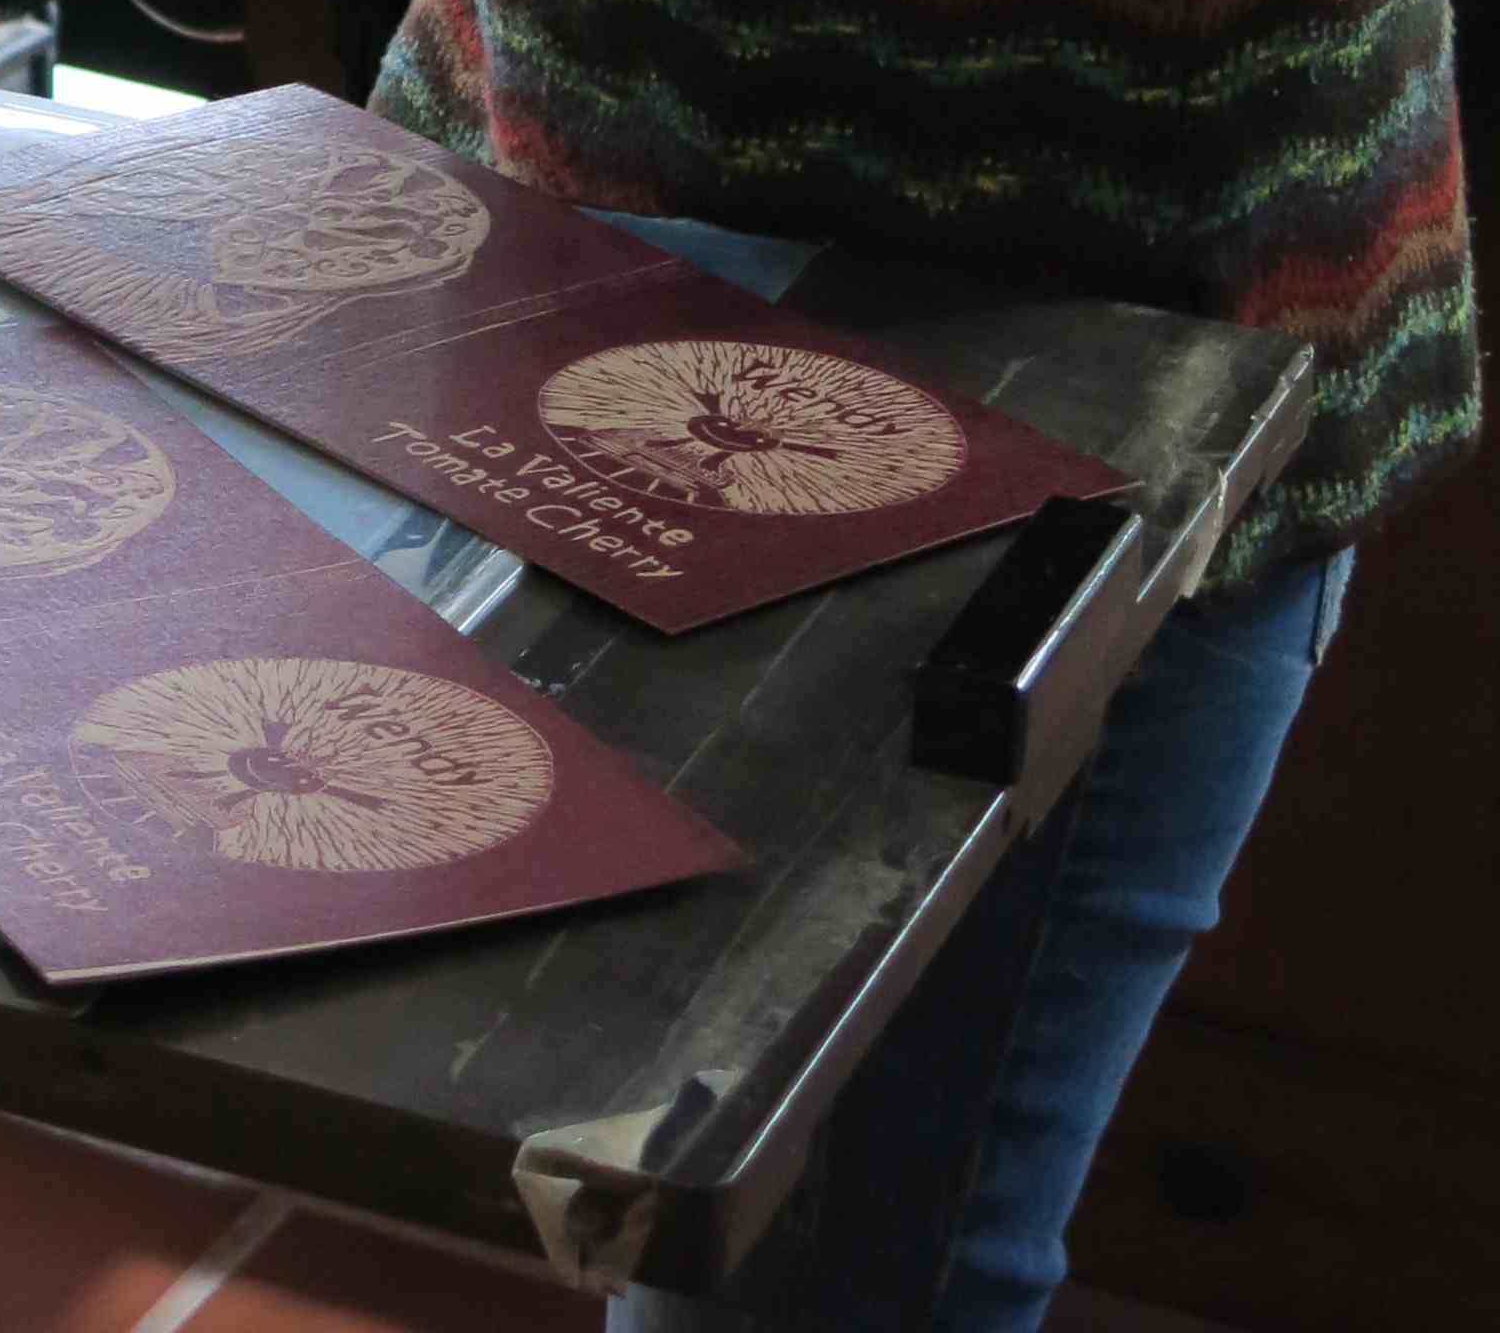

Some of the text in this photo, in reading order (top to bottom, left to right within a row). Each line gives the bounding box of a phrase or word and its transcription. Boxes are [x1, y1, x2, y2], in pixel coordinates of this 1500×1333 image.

[731, 361, 913, 436] Wendy
[371, 421, 685, 578] Tomate Cherry
[450, 424, 695, 547] La Valiente
[323, 686, 495, 786] Wendy
[3, 764, 153, 882] Valiente
